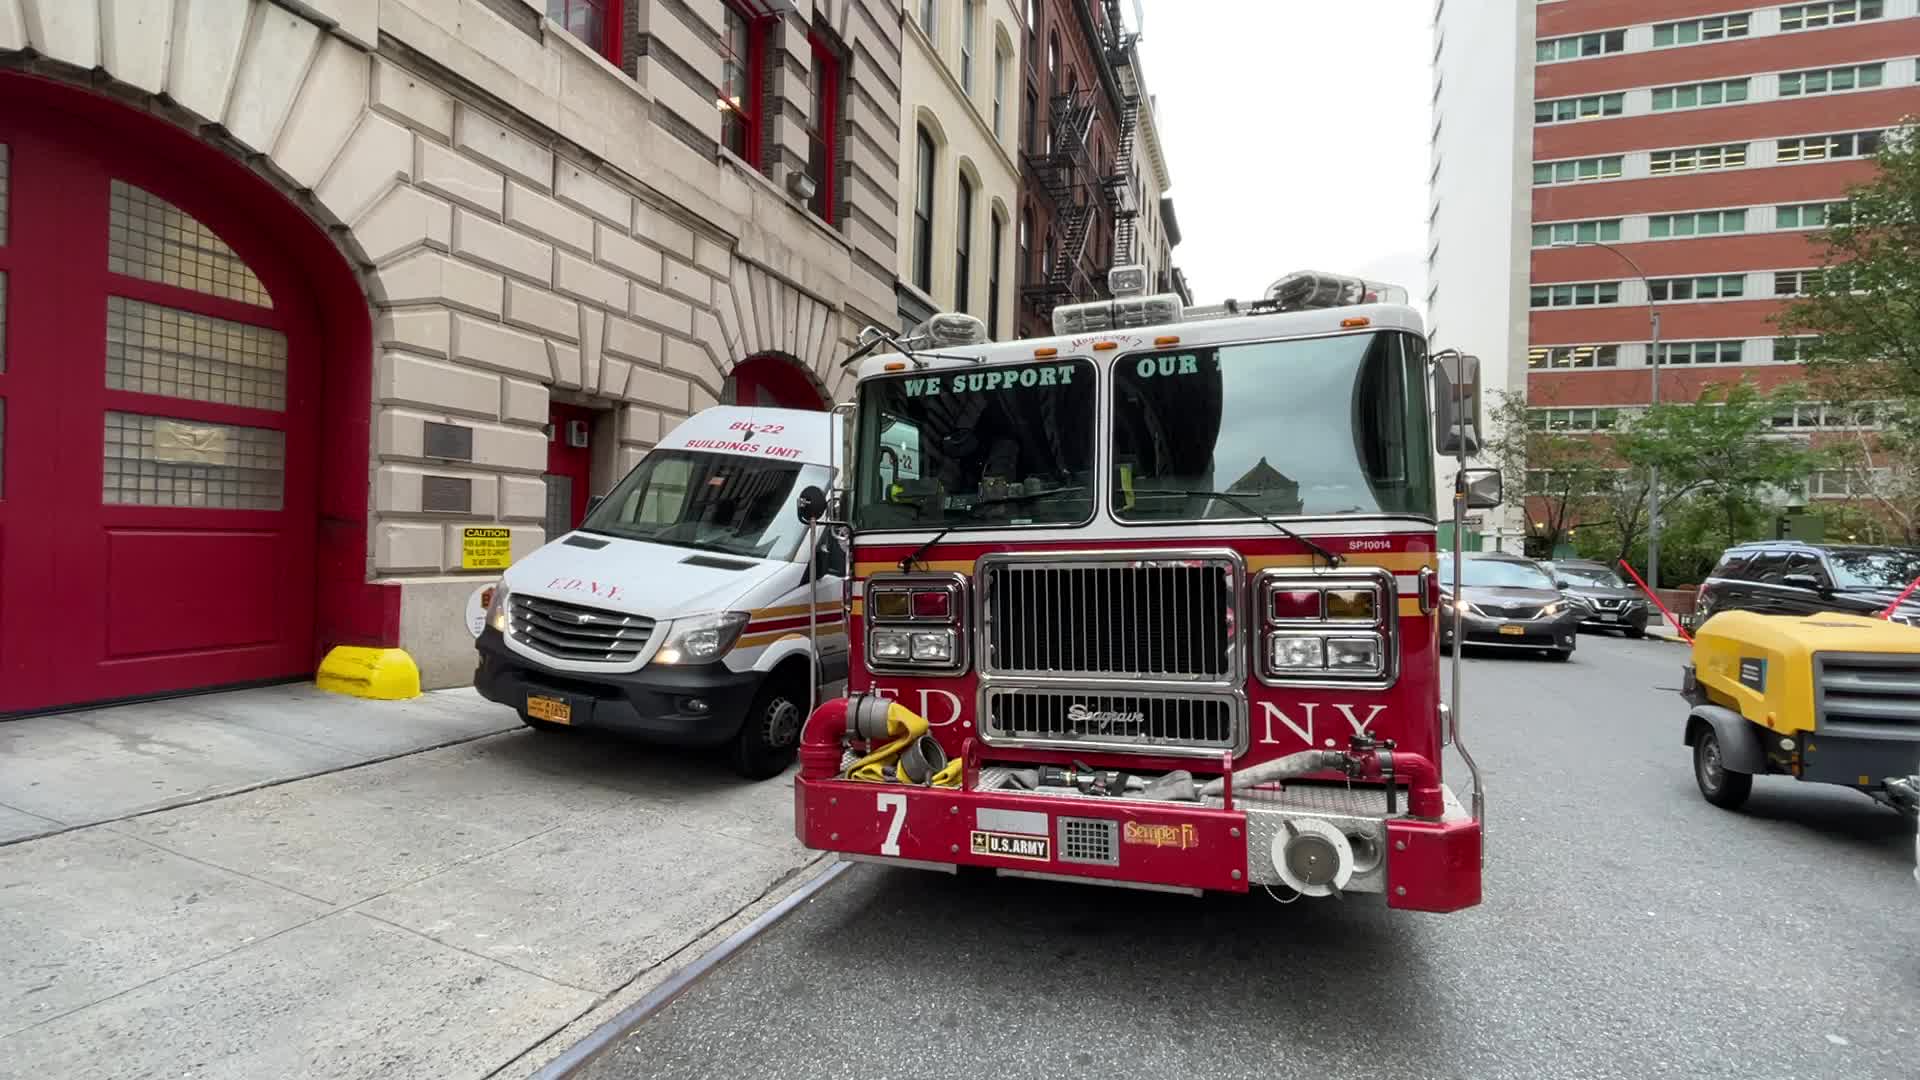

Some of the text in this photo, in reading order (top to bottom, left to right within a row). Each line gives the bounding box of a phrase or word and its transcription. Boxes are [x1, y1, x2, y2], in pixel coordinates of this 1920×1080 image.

[1136, 354, 1199, 378] OUR
[904, 365, 1075, 398] WE SUPPORT
[685, 440, 803, 459] BUILDINGS UNIT
[466, 529, 508, 537] CAUTION
[1349, 540, 1391, 550] SP10014
[546, 578, 623, 600] F.D.N.Y.
[1067, 704, 1144, 729] Seagrave
[877, 792, 907, 857] 7
[1127, 821, 1193, 851] Semper Fi
